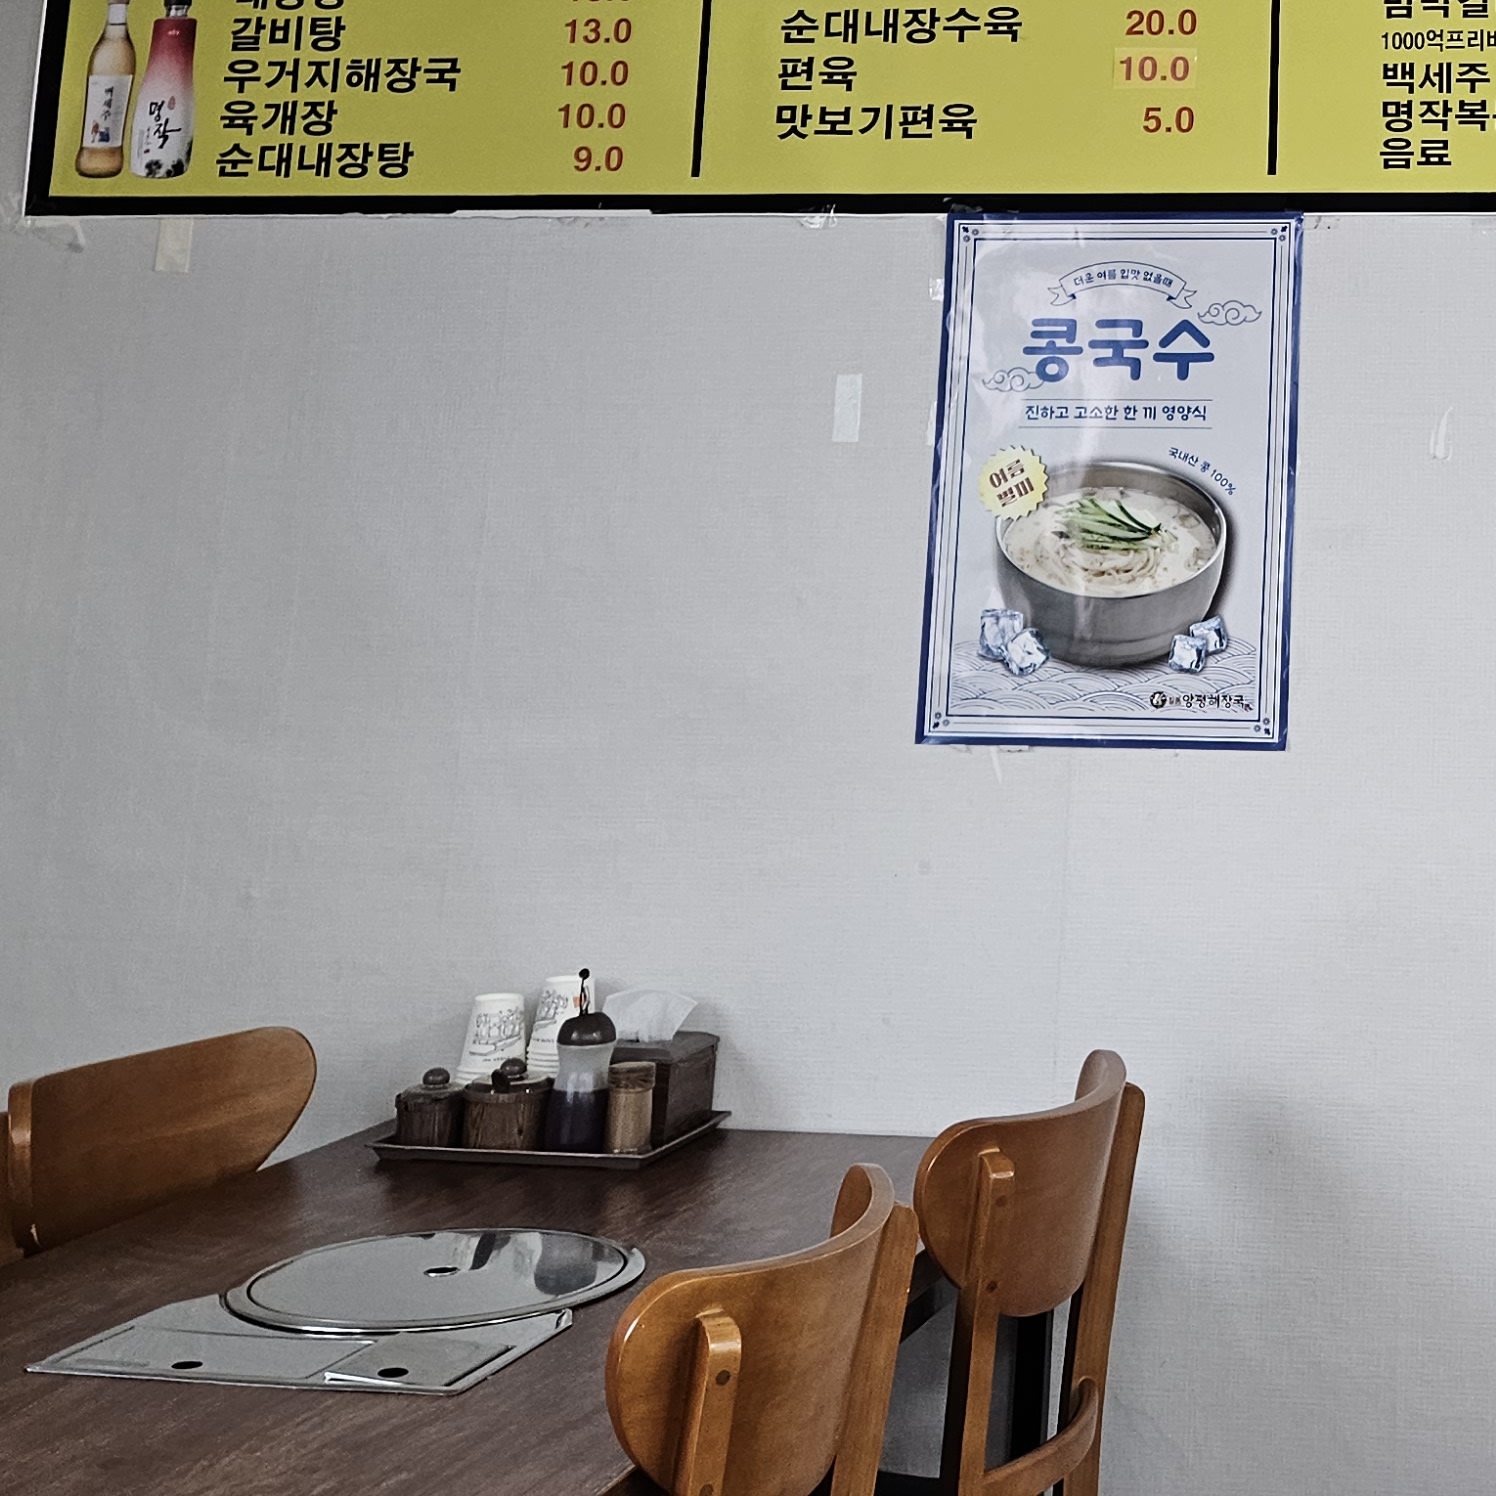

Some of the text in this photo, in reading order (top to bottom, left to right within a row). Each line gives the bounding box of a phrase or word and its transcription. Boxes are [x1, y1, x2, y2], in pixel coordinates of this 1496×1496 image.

[230, 15, 632, 52] 갈비탕 13.0
[780, 6, 1198, 45] 순대내장수육 20.0
[223, 57, 629, 94] 우거지해장국 10.0
[777, 55, 1191, 92] 편육 10.0
[1382, 61, 1491, 95] 백세주
[219, 99, 627, 137] 육개장 10.0
[775, 103, 1195, 140] 맛보기편육 5.0
[215, 141, 624, 179] 순대내장탕 9.0
[1379, 137, 1452, 170] 음료
[1023, 318, 1214, 382] 콩국수
[1025, 405, 1206, 421] 진하고 고소한 한 끼 영양식
[1169, 447, 1236, 495] 국내산 콩 100%
[1182, 693, 1244, 708] 양평해장국
